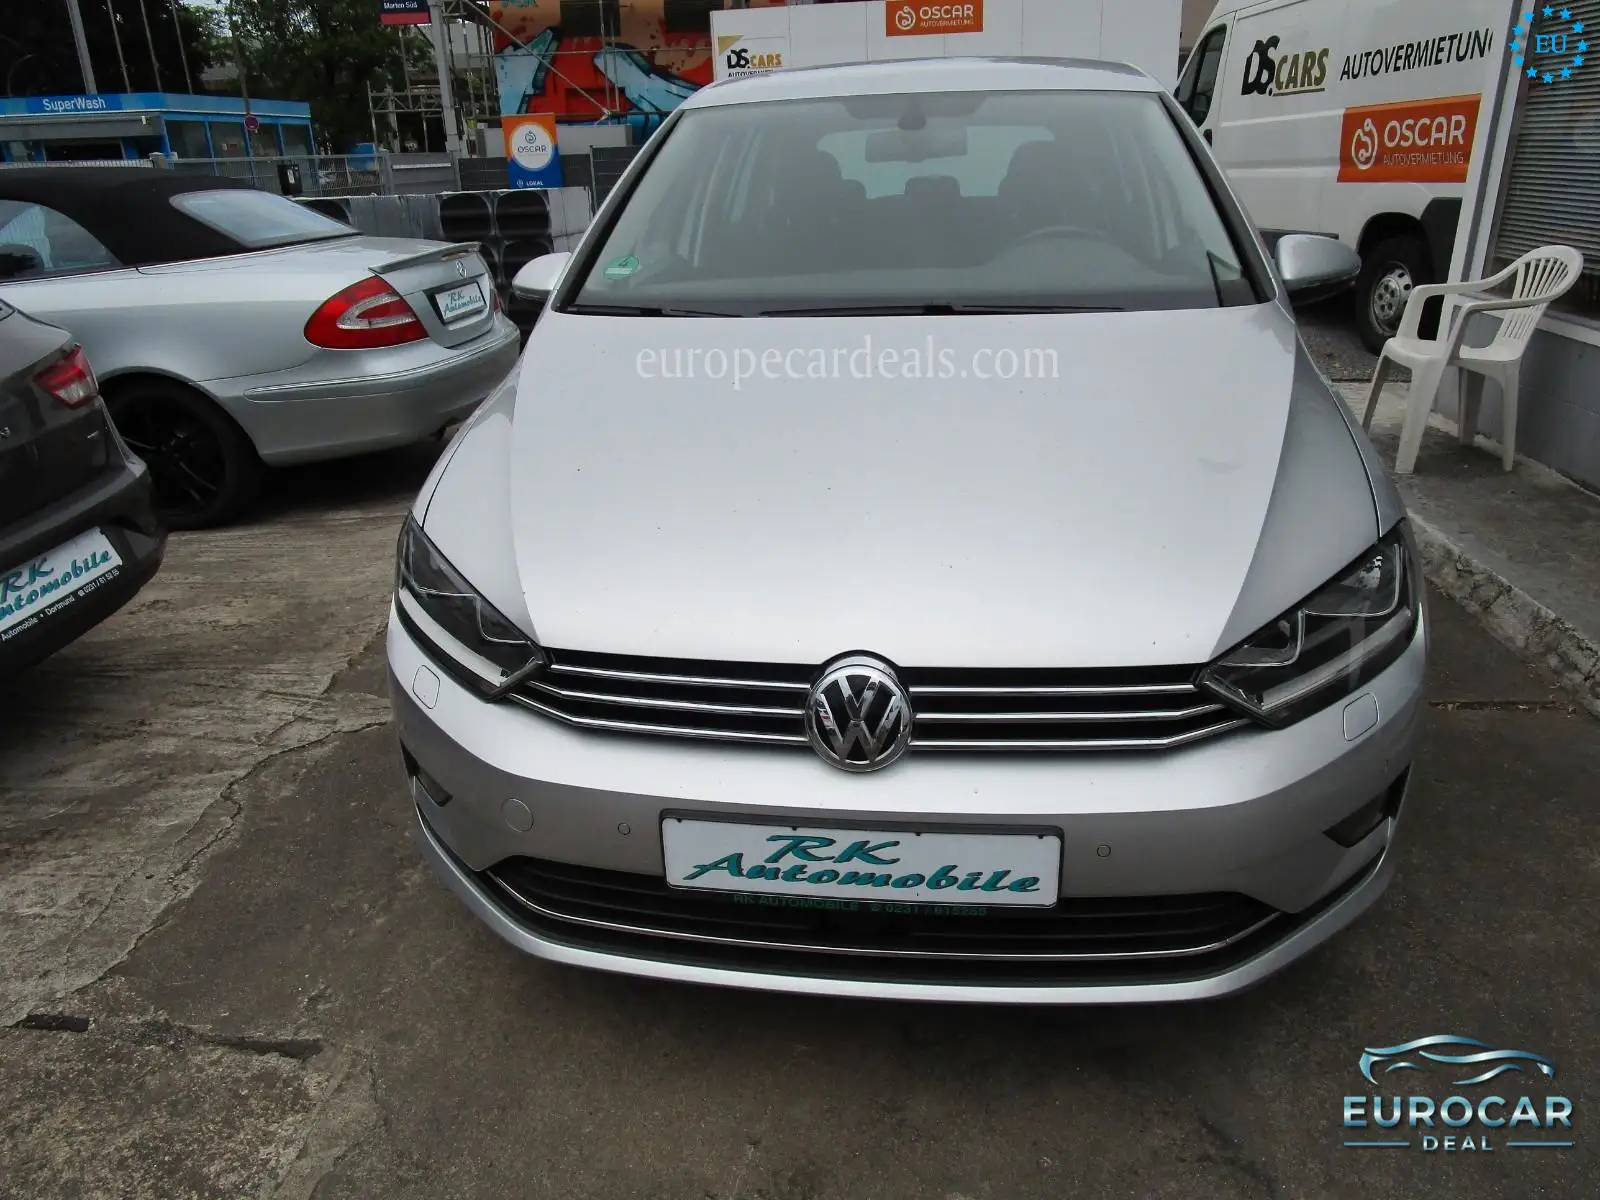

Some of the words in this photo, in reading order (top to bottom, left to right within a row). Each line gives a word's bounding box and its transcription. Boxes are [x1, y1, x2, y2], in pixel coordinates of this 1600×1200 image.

[919, 4, 975, 20] OSCAR
[1339, 28, 1495, 82] AUTOVERMIETUN
[42, 97, 106, 112] SuperWash
[1383, 114, 1467, 148] OSCAR
[517, 145, 548, 154] OSCAR
[1383, 152, 1464, 167] AUTOVERMIETUNG
[0, 550, 113, 621] utomobile
[1, 616, 39, 641] Automobile
[45, 595, 75, 616] Dortmund
[765, 834, 901, 866] RK
[682, 852, 1043, 893] Automobile
[758, 896, 860, 912] AUTOMOBILE
